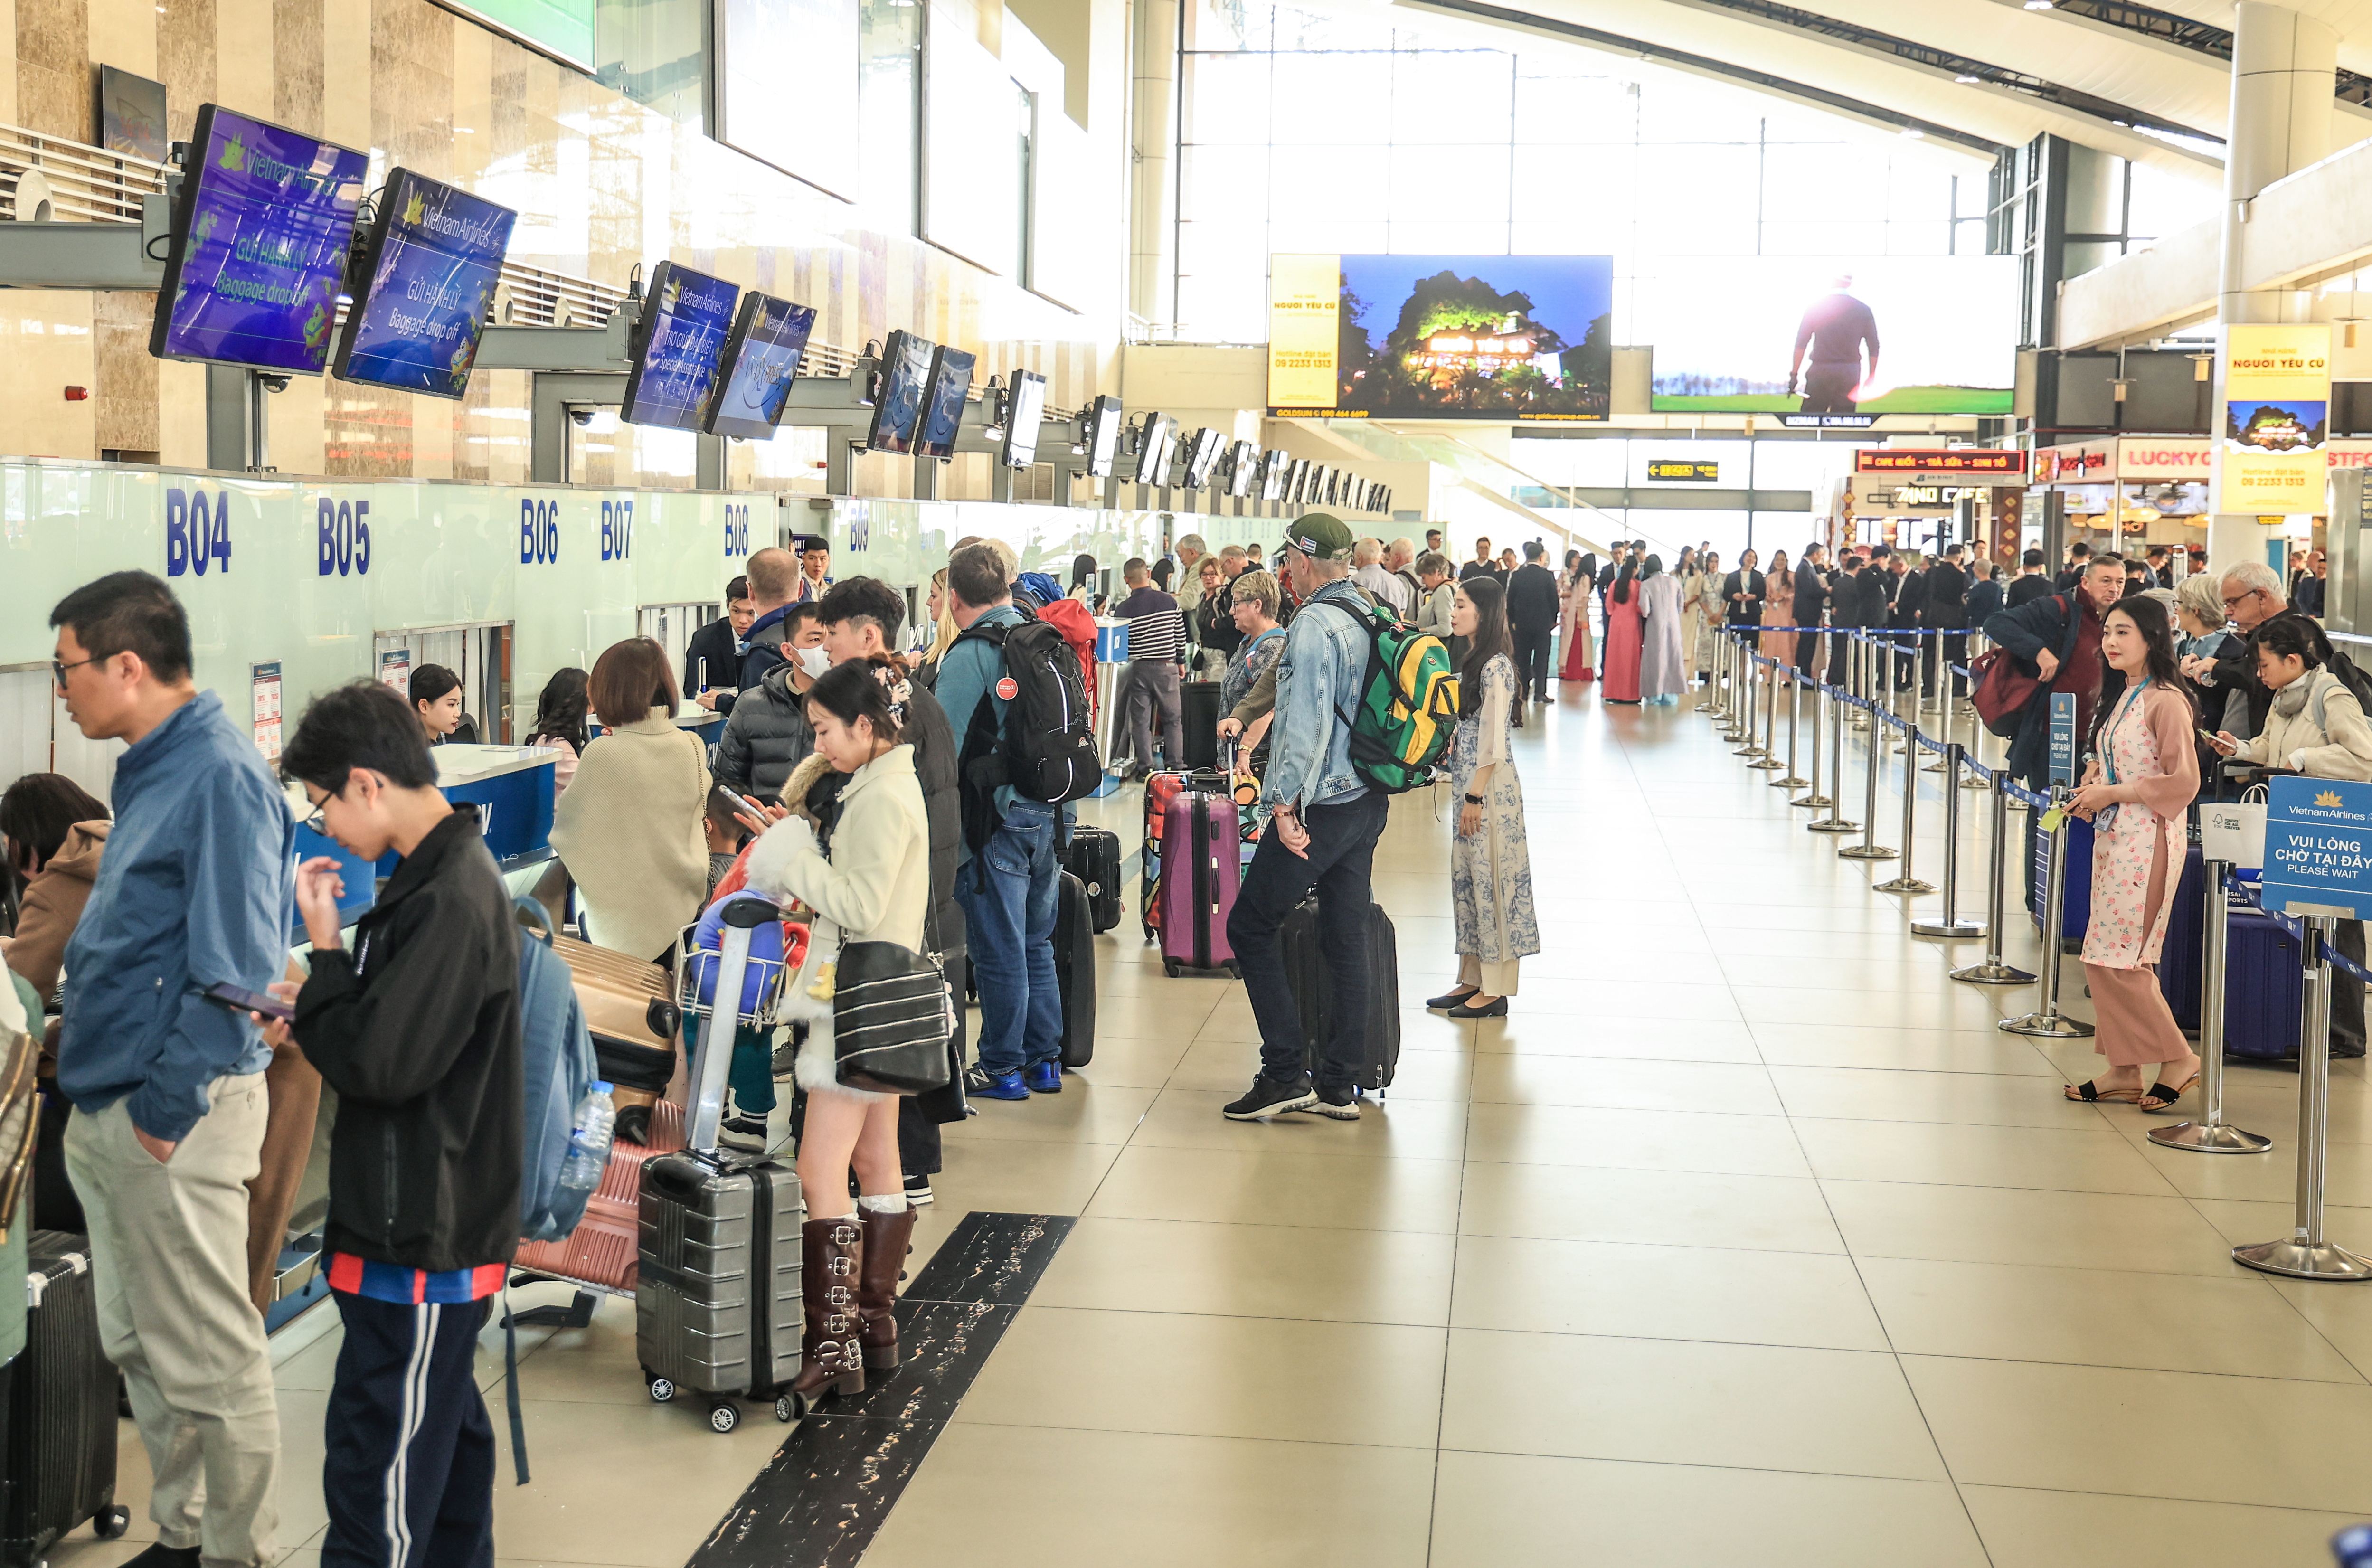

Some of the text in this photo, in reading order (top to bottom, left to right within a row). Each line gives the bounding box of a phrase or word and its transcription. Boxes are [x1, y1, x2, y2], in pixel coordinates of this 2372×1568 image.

[247, 147, 295, 186] Vietnam
[423, 204, 491, 248] Vietnam Airlines
[217, 271, 311, 310] Baggage drop off
[680, 286, 723, 315] Vietnam Airlines
[389, 307, 461, 342] Baggage drop off
[659, 351, 705, 378] Special Assistance
[1275, 359, 1332, 368] 09 2233 1313
[1276, 409, 1312, 417] GOLDSUN
[2129, 451, 2198, 466] LUCKY
[1941, 487, 1988, 504] CAFE
[2257, 478, 2282, 486] 2233
[167, 489, 232, 577] B04
[319, 497, 370, 576] B05
[521, 499, 558, 565] B06
[602, 500, 633, 561] B07
[725, 504, 748, 557] B08
[851, 508, 869, 552] B09
[2289, 806, 2365, 821] Vietnam Airlines
[2289, 835, 2361, 852] VUI LÒNG
[2275, 849, 2372, 869] CHỜ TẠI ĐÂY
[2287, 864, 2359, 879] PLEASE WAIT
[969, 1069, 990, 1086] N
